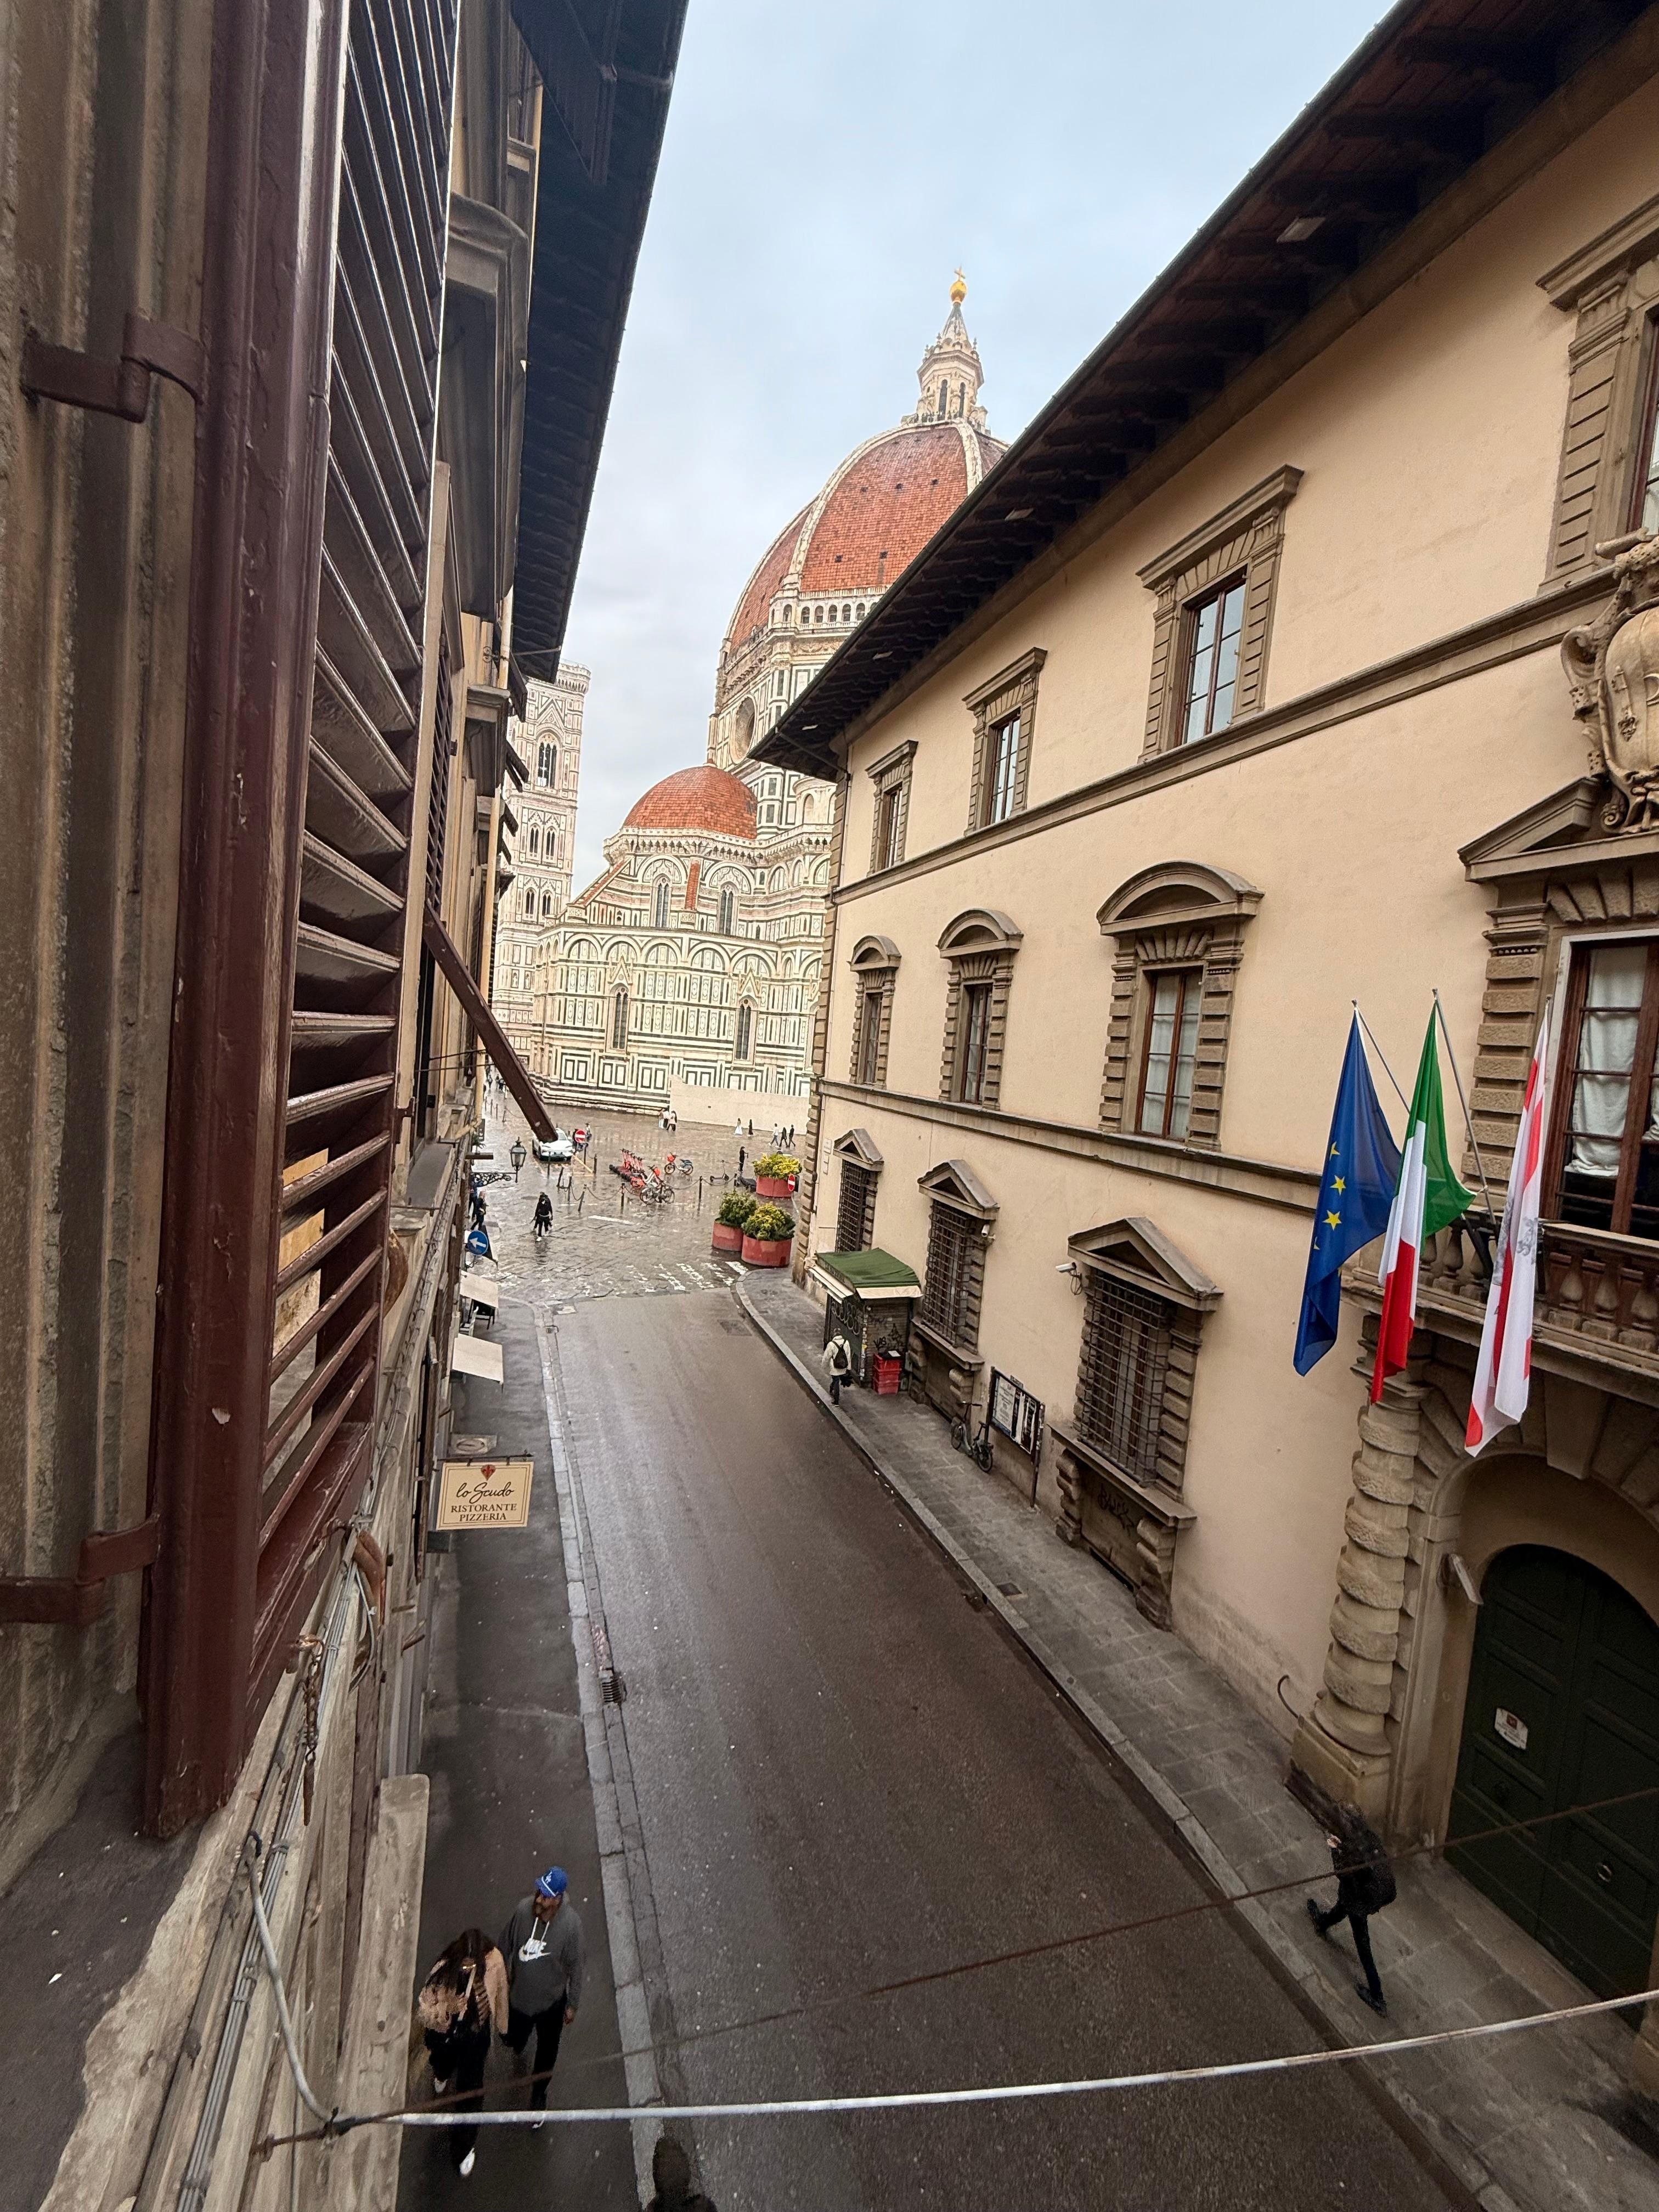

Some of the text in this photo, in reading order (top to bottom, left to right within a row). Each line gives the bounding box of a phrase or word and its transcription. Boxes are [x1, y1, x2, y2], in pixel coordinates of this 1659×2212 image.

[469, 1481, 515, 1504] Scudo
[451, 1503, 517, 1513] RISTORANTE
[459, 1513, 506, 1522] PIZZERIA
